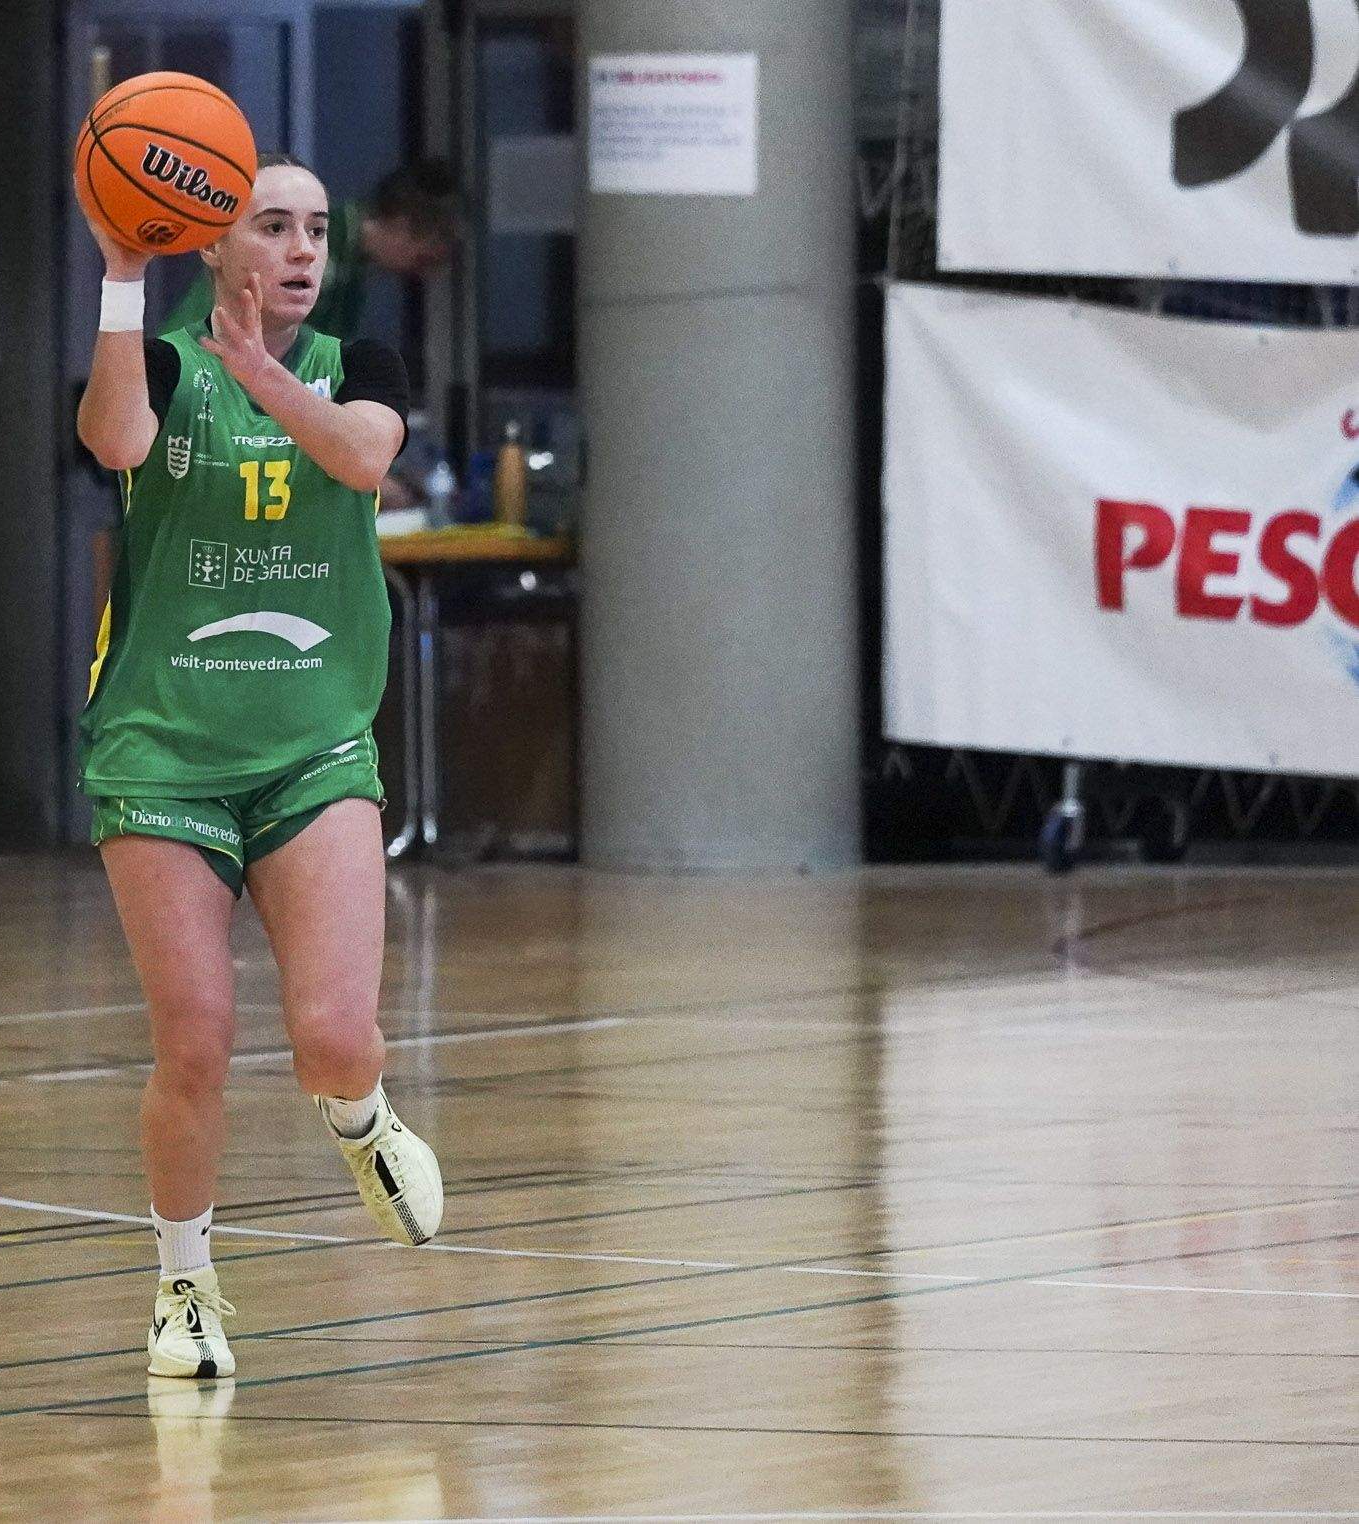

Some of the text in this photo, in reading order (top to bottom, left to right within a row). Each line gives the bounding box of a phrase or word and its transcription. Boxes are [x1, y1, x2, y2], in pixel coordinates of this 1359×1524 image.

[143, 141, 239, 215] Wilson
[240, 459, 292, 520] 13
[234, 545, 292, 565] XUNTA
[232, 562, 330, 583] DE GALICIA
[170, 653, 323, 672] visit-pontevedra.com
[132, 809, 171, 827] Diario
[183, 815, 240, 845] Pontevedra
